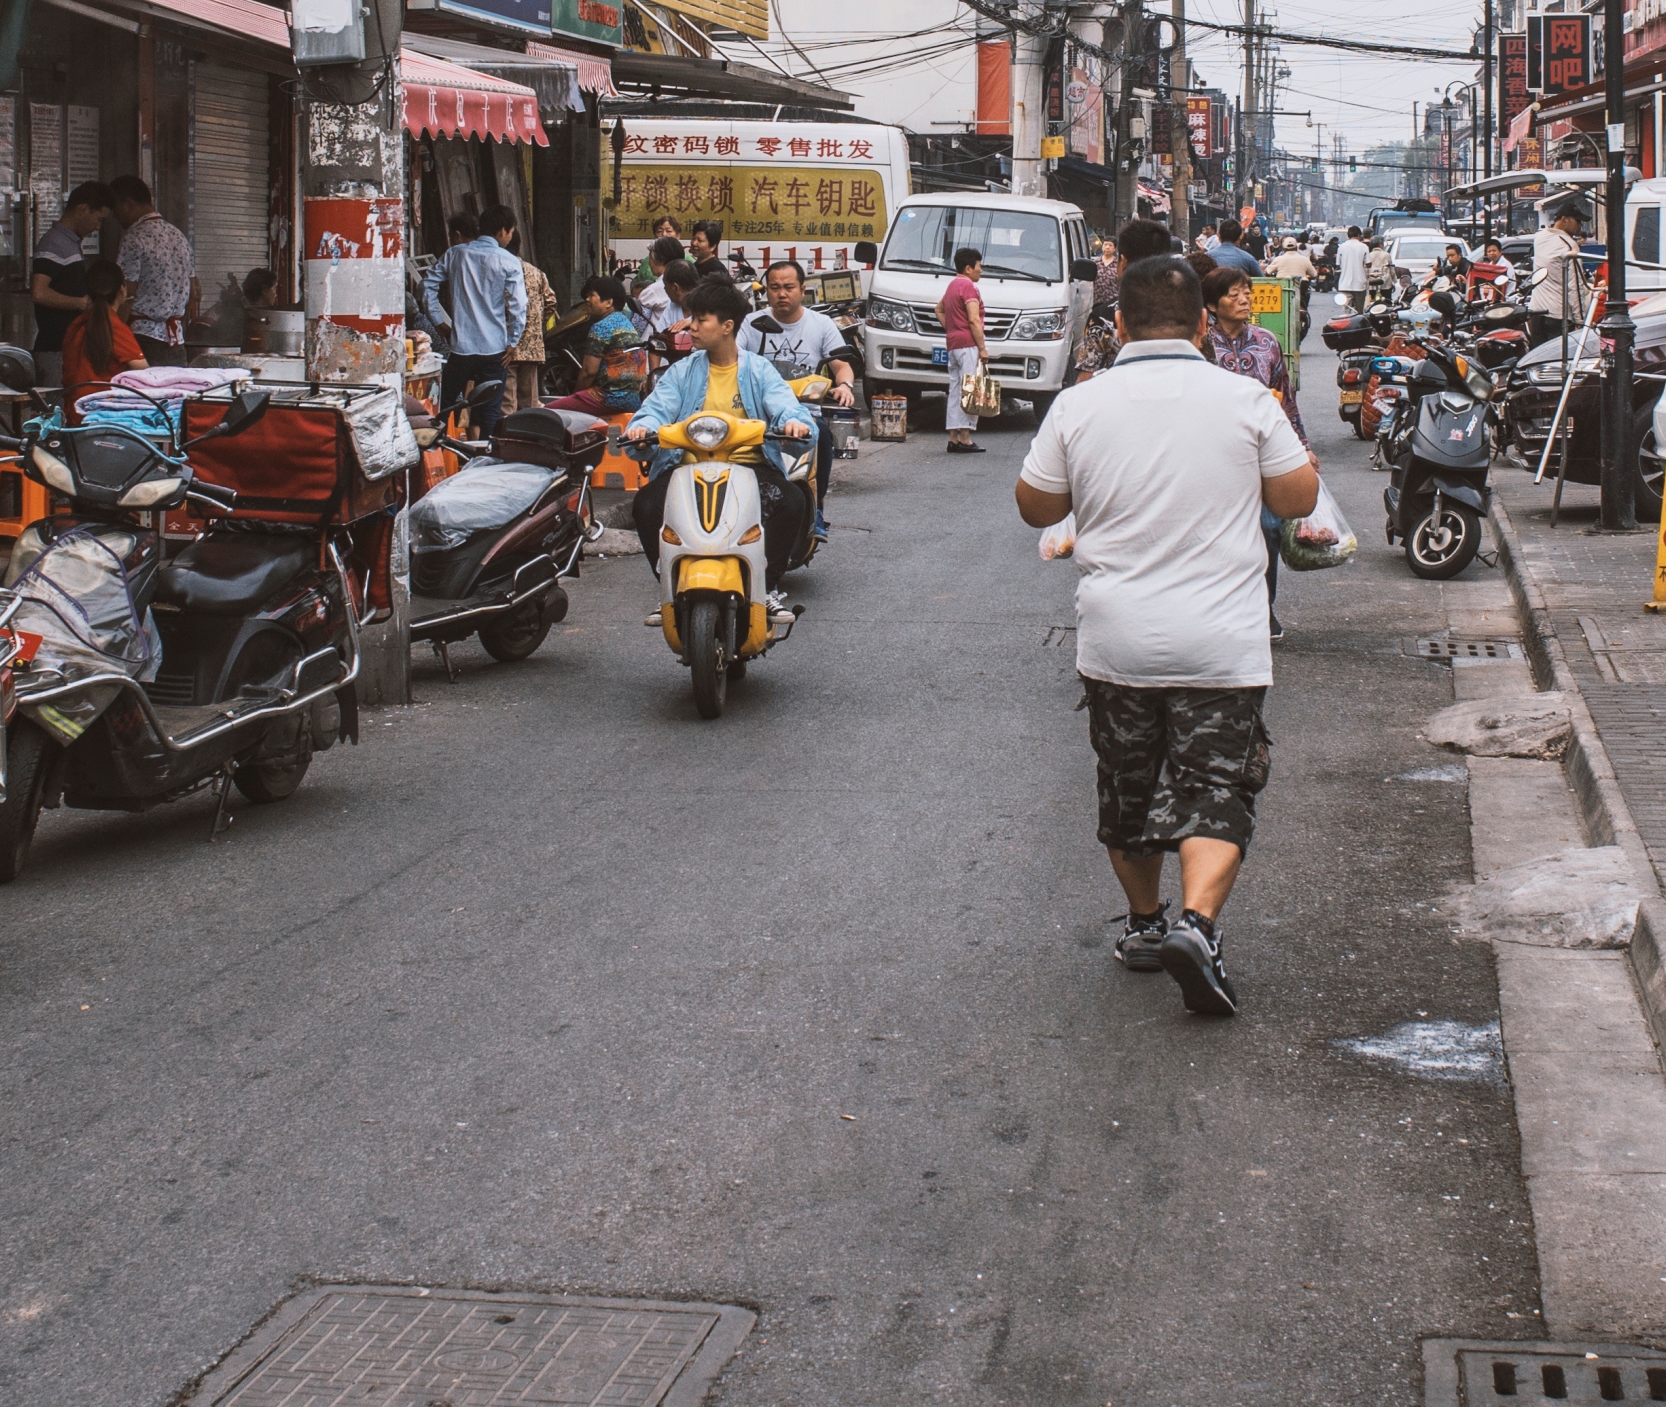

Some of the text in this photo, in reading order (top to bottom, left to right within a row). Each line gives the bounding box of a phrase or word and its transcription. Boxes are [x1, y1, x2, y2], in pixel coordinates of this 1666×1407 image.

[1550, 19, 1585, 91] 网吧
[1068, 86, 1086, 98] 超市
[1187, 100, 1208, 109] 特色
[755, 137, 875, 160] 零售批发
[750, 177, 876, 218] 汽车钥匙
[731, 220, 785, 235] 专注25年
[792, 221, 875, 238] 专业值得信赖
